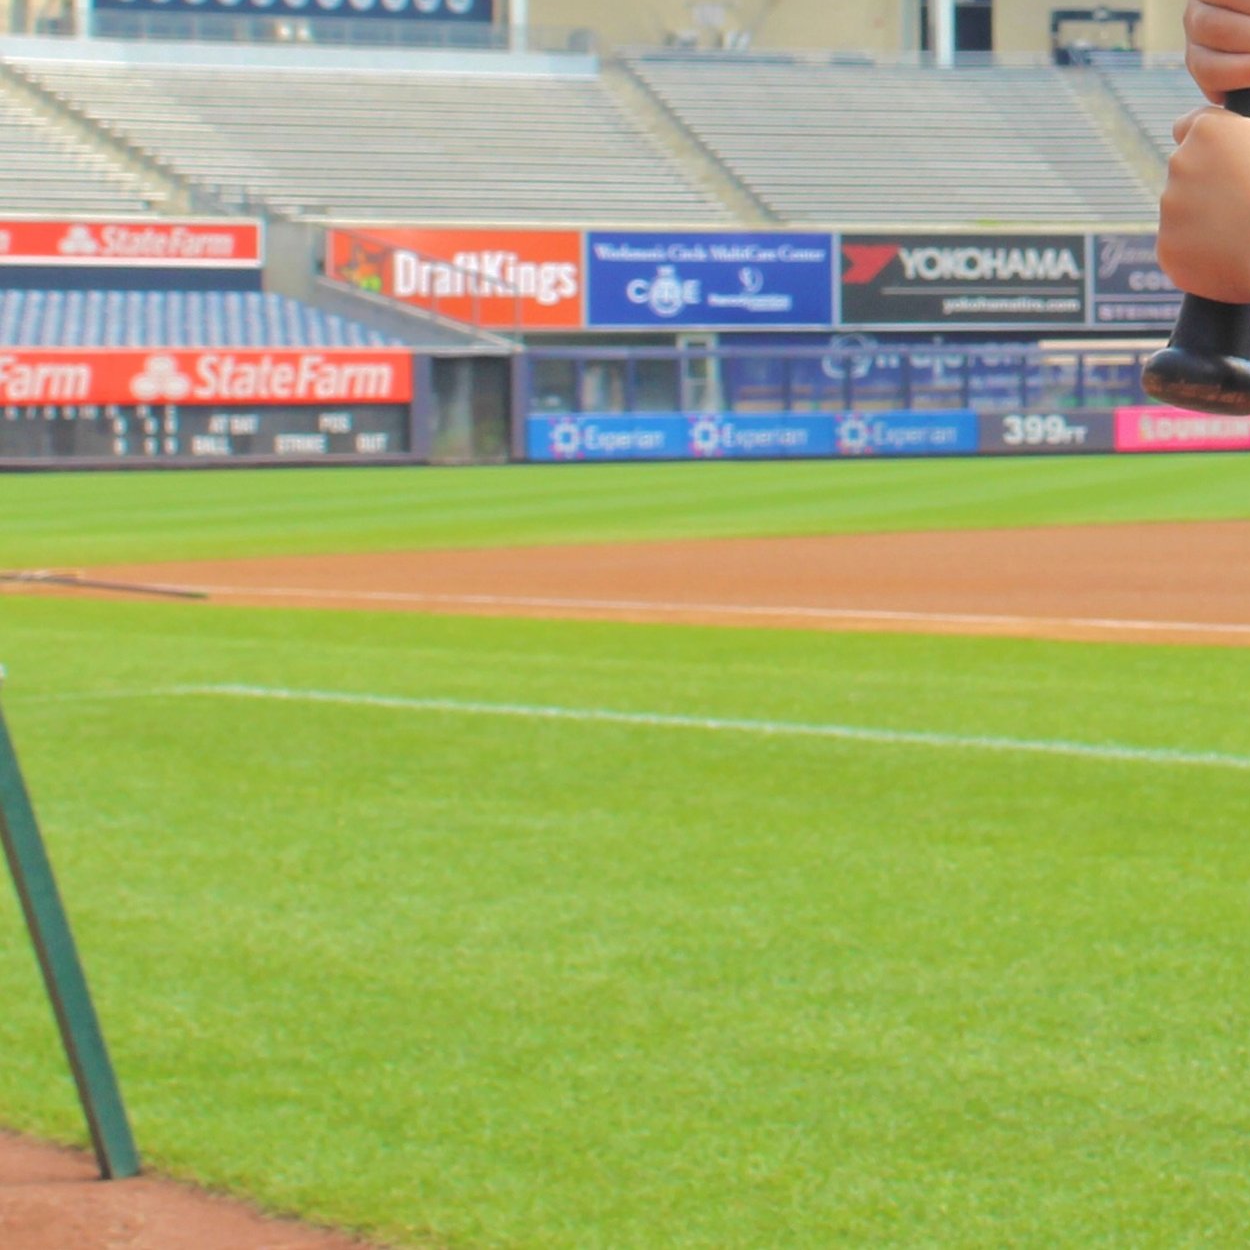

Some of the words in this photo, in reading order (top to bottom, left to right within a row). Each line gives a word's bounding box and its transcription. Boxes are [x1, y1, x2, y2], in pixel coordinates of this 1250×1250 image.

[101, 225, 166, 257] State
[168, 226, 235, 257] Farm
[393, 249, 579, 306] DraftKings
[898, 246, 1081, 281] YOKOHAMA
[194, 355, 291, 399] State
[295, 357, 393, 400] Farm
[355, 432, 388, 452] OUT
[722, 423, 808, 449] Experian
